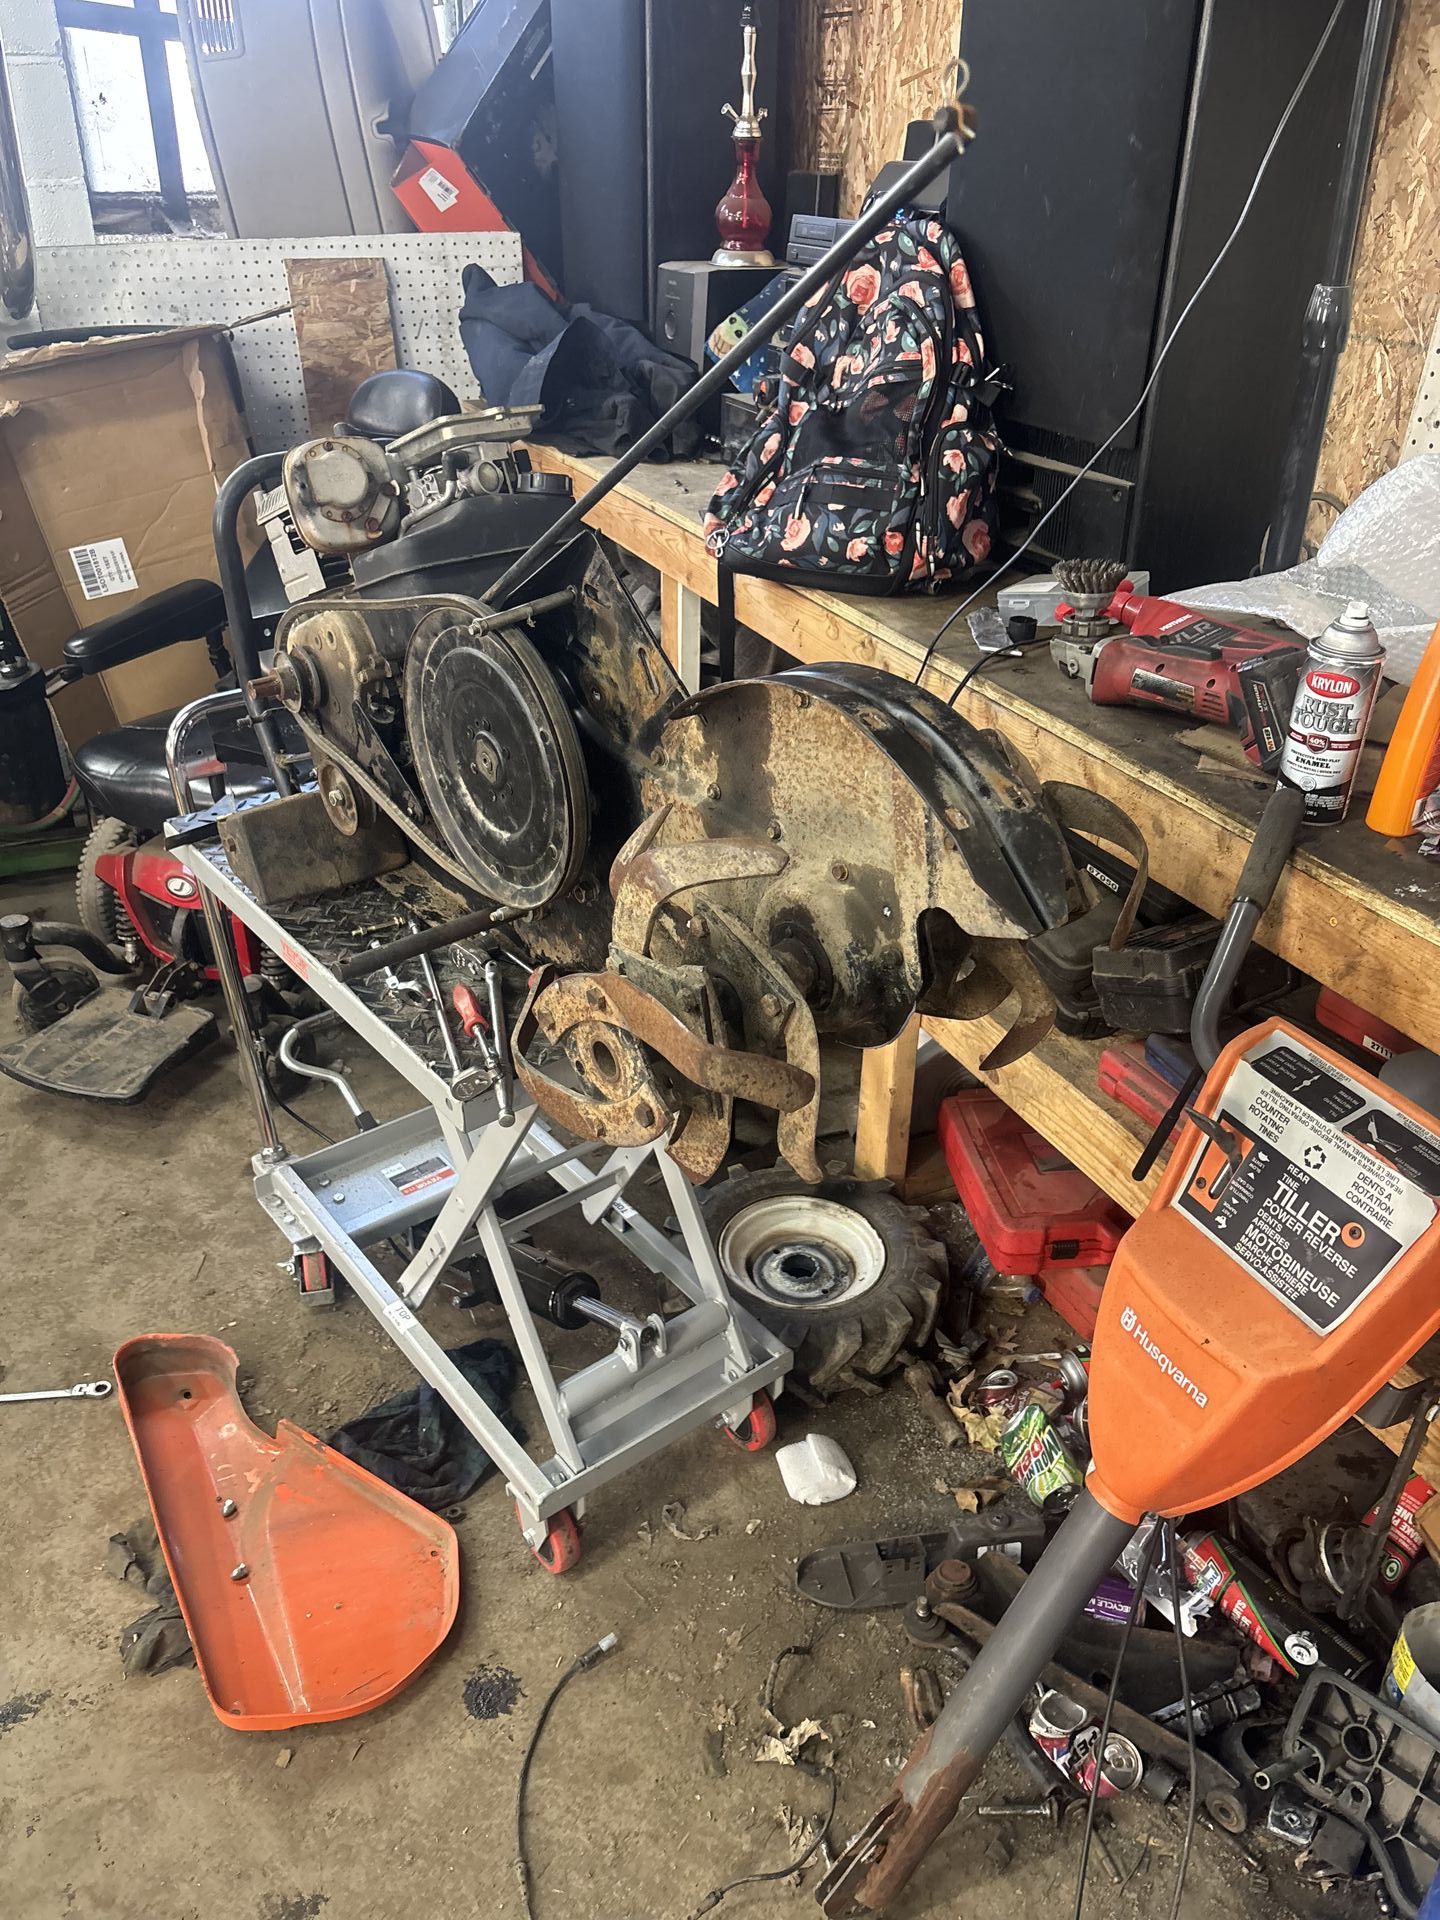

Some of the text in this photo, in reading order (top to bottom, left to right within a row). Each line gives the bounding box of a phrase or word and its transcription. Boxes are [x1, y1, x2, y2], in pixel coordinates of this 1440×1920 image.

[1311, 674, 1353, 694] KRYLON
[1302, 694, 1354, 718] RUST
[1294, 705, 1361, 735] TOUGH
[1263, 728, 1276, 752] M18
[1309, 736, 1326, 746] 40%
[1295, 756, 1331, 769] ENAMEL
[1259, 1088, 1280, 1105] TILLER
[1268, 1086, 1295, 1108] MACHINE
[1248, 1104, 1285, 1136] ROTATING
[1255, 1097, 1290, 1126] COUNTER
[1276, 1100, 1311, 1128] OPERATING
[1258, 1124, 1280, 1145] TINES
[1308, 1123, 1334, 1145] BEFORE
[1330, 1130, 1355, 1151] AVANT
[1331, 1140, 1359, 1162] MANUAL
[1351, 1146, 1378, 1167] MANUEL
[1281, 1172, 1300, 1191] TINE
[1286, 1163, 1310, 1185] REAR
[1383, 1169, 1401, 1184] LIRE
[1351, 1181, 1394, 1216] ROTATION
[1356, 1171, 1392, 1202] DENTS A
[1383, 1178, 1404, 1195] READ
[1256, 1208, 1283, 1232] DENTS
[1272, 1179, 1342, 1247] TILLER
[1345, 1190, 1394, 1230] CONTRAIRE
[1251, 1217, 1291, 1250] ARRIERES
[1262, 1197, 1358, 1279] POWER REVERSE
[1234, 1242, 1300, 1301] SERVO-ASSISTEE
[1239, 1235, 1309, 1297] MARCHE ARRIERE
[1243, 1224, 1341, 1309] MOTOBINEUSE
[395, 1306, 411, 1320] TOP
[1132, 1322, 1208, 1408] Husqvarna
